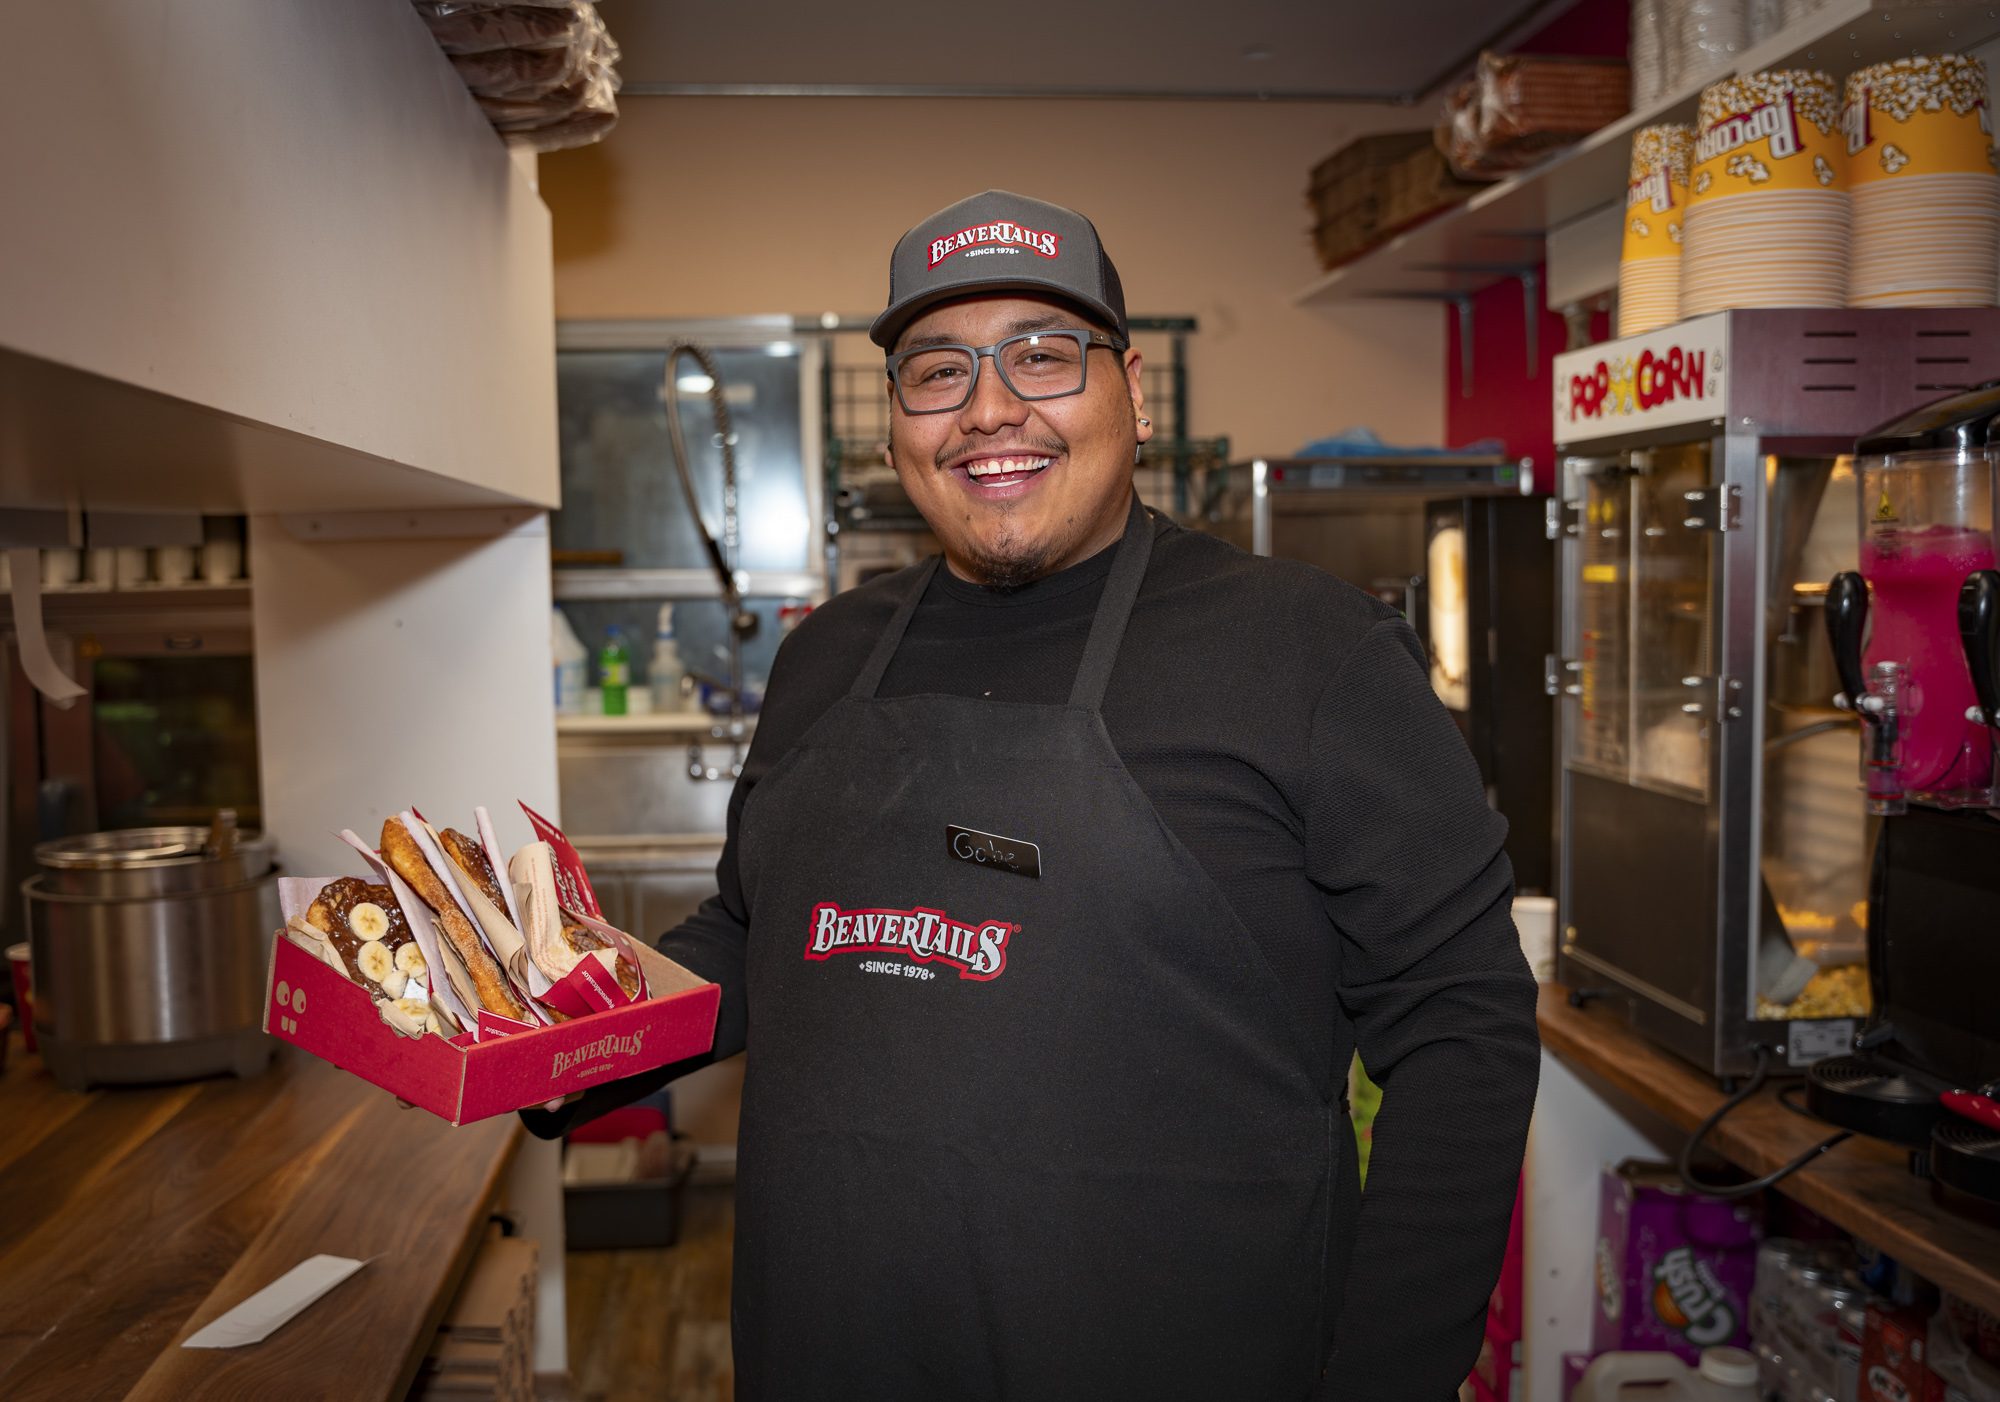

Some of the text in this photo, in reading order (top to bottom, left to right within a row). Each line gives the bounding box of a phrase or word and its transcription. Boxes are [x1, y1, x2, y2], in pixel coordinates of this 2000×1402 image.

[931, 222, 1056, 265] BEAVERTAILS
[969, 247, 1015, 257] SINCE 1978
[1571, 345, 1705, 422] POP CORN
[811, 907, 1007, 975] BEAVERTAILS
[865, 961, 930, 980] SINCE 1978
[550, 1029, 645, 1079] BEAVERTAILS
[580, 1065, 598, 1078] SINCE
[1654, 1247, 1734, 1343] Crush
